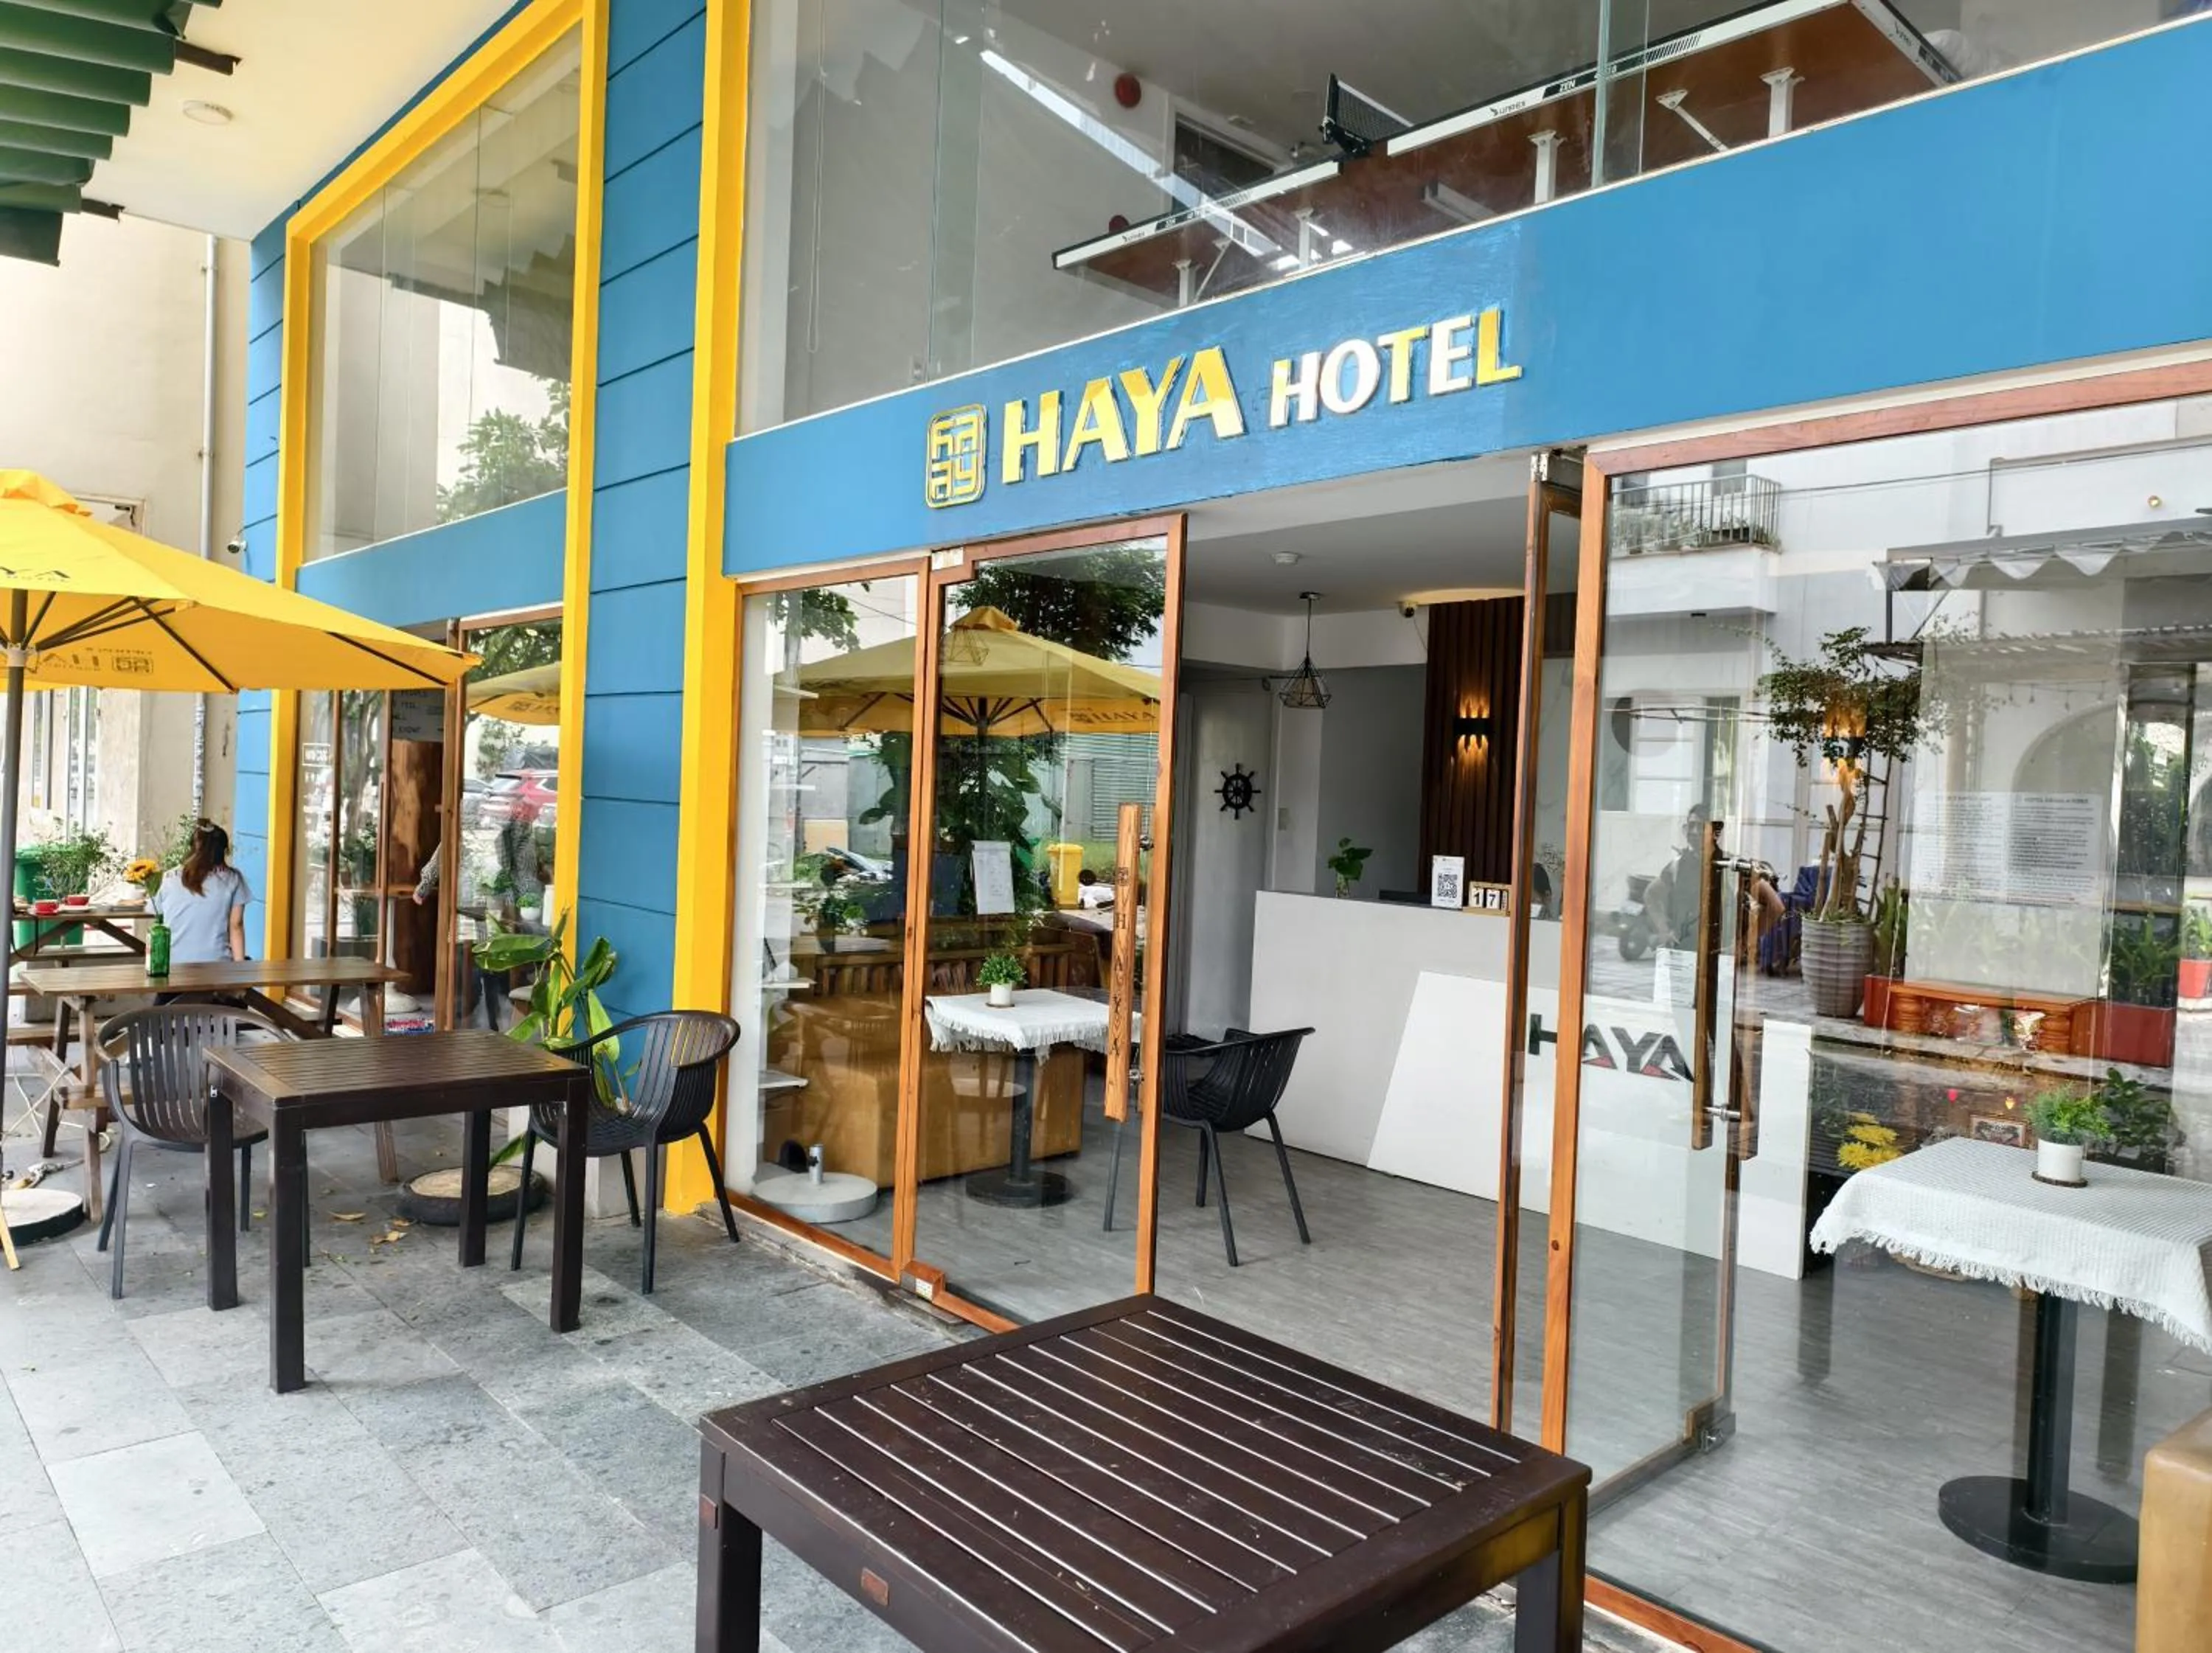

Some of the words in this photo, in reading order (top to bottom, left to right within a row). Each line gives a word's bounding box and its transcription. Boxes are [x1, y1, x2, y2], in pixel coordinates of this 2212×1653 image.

[1001, 346, 1246, 484] HAYA
[1269, 307, 1522, 428] HOTEL
[1528, 1014, 1694, 1082] HAYA
